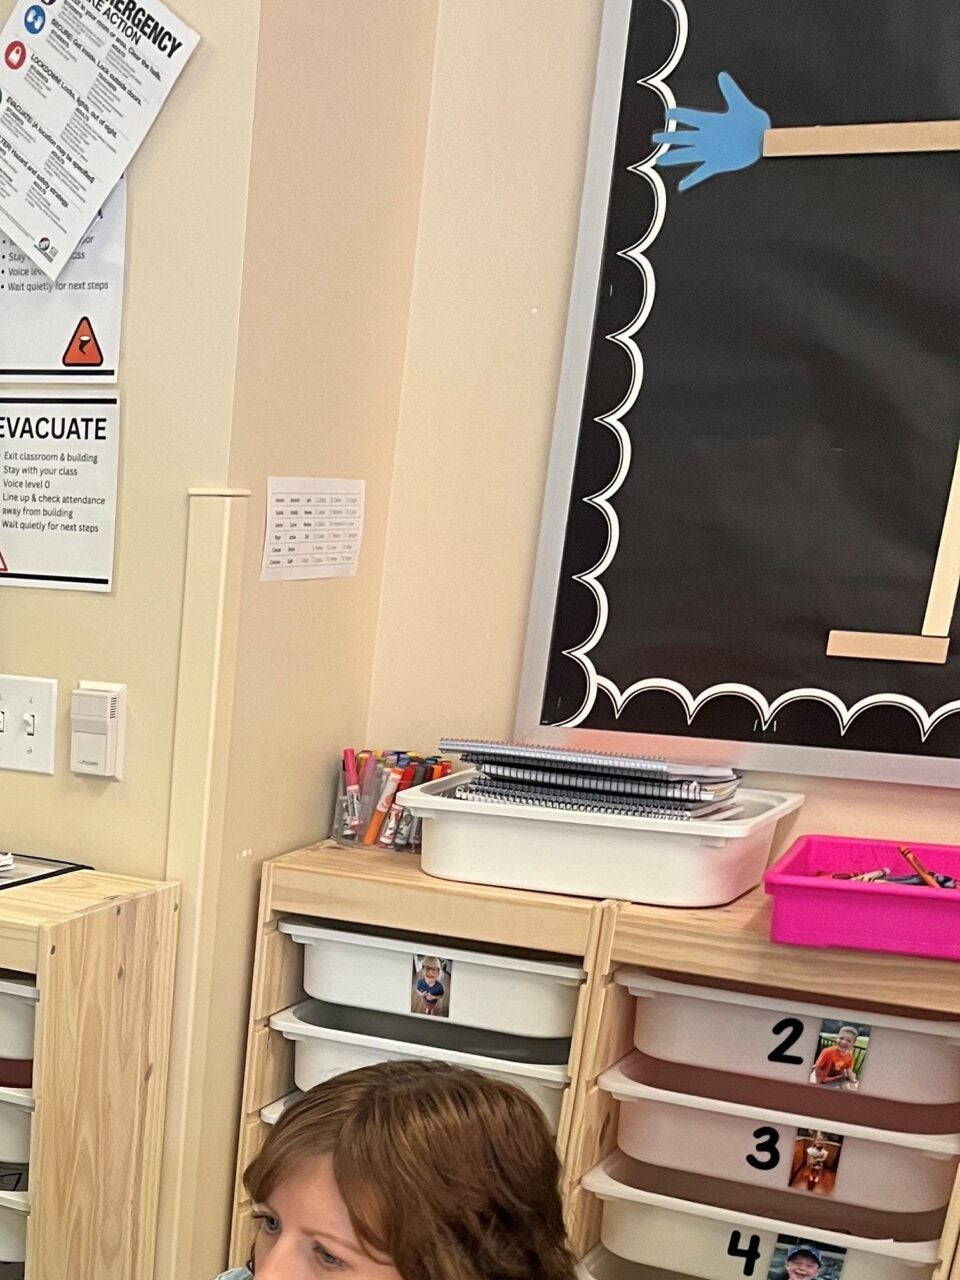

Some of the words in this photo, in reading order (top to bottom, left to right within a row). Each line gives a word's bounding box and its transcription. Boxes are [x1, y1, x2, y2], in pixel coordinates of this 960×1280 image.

[102, 7, 141, 45] ACTION
[106, 0, 183, 58] ERGENCY
[96, 60, 109, 74] Lock
[90, 111, 99, 120] out
[38, 126, 56, 146] location
[56, 145, 66, 157] may
[66, 154, 72, 162] be
[11, 149, 28, 167] Hazard
[26, 165, 37, 176] and
[36, 174, 49, 189] safety
[8, 252, 26, 263] Stay
[8, 267, 29, 276] Voice
[7, 282, 25, 291] Wait
[26, 282, 53, 293] quietly
[55, 281, 67, 290] for
[68, 281, 85, 290] next
[87, 281, 109, 291] steps
[3, 452, 18, 461] Exit
[19, 452, 59, 461] classroom
[59, 453, 66, 462] &
[66, 453, 98, 464] building
[3, 465, 20, 476] Stay
[21, 466, 39, 475] with
[39, 468, 57, 477] your
[58, 467, 78, 476] class
[3, 479, 24, 488] Voice
[25, 479, 43, 489] level
[2, 493, 19, 502] Line
[20, 494, 31, 504] up
[31, 494, 37, 503] &
[38, 494, 61, 503] check
[61, 495, 106, 505] attendance
[2, 508, 21, 517] away
[22, 506, 41, 516] from
[42, 507, 74, 519] building
[1, 519, 19, 529] Wait
[20, 520, 46, 531] quietly
[47, 521, 59, 531] for
[60, 522, 77, 532] next
[78, 523, 99, 533] steps
[767, 1018, 804, 1065] 2
[745, 1126, 780, 1170] 3
[727, 1230, 761, 1277] 4
